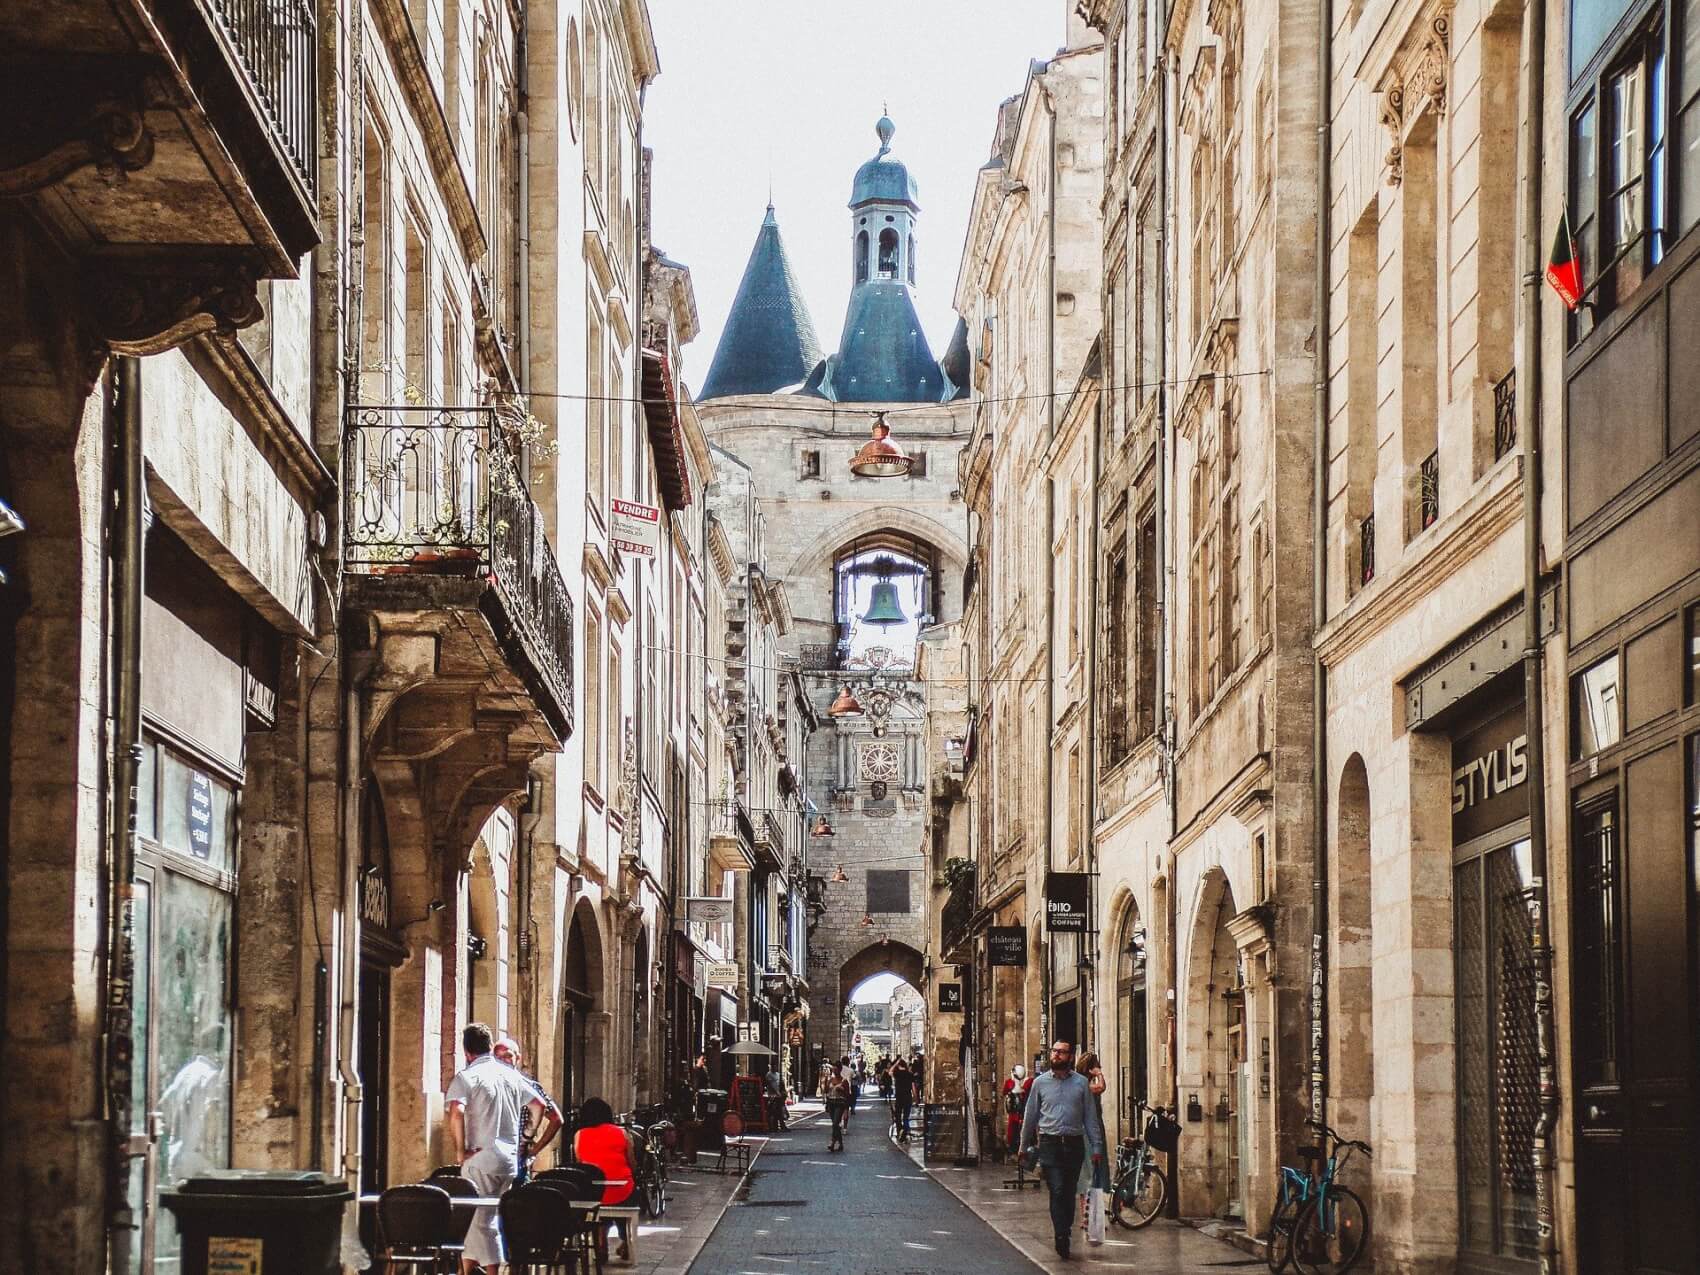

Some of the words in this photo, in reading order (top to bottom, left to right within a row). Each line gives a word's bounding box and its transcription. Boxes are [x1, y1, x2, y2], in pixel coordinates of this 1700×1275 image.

[618, 503, 653, 519] VENDRE
[1453, 734, 1527, 814] STYLIS
[1048, 899, 1071, 912] ÉDITO
